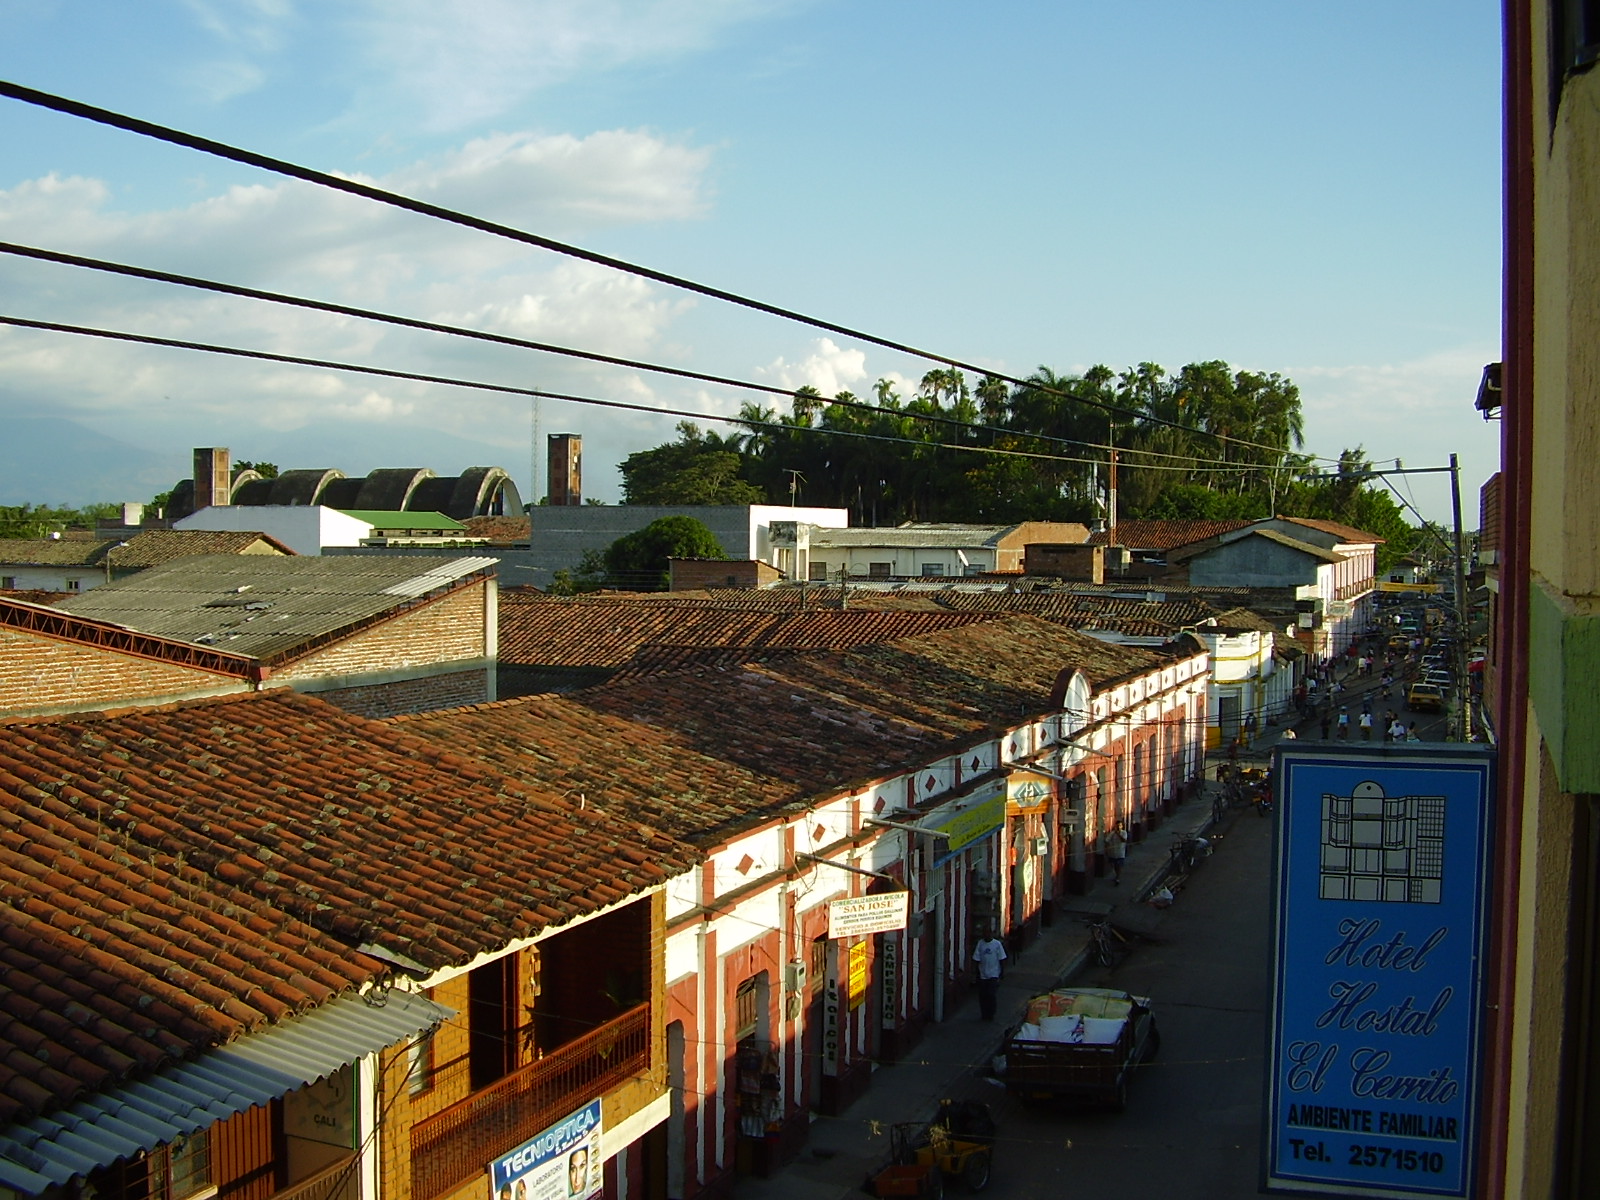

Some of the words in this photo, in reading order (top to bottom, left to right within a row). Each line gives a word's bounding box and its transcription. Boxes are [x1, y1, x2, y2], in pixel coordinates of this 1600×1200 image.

[1324, 918, 1448, 973] Hotel
[885, 944, 894, 1020] CAMPESINO
[1315, 980, 1453, 1037] Hostal
[1287, 1040, 1338, 1093] El
[1350, 1047, 1458, 1104] Cerrito
[314, 1114, 336, 1127] CALI
[1287, 1103, 1371, 1133] AMBIENTE
[1379, 1110, 1457, 1140] FAMILIAR
[1288, 1139, 1331, 1163] Tel.
[1348, 1143, 1443, 1173] 2571510
